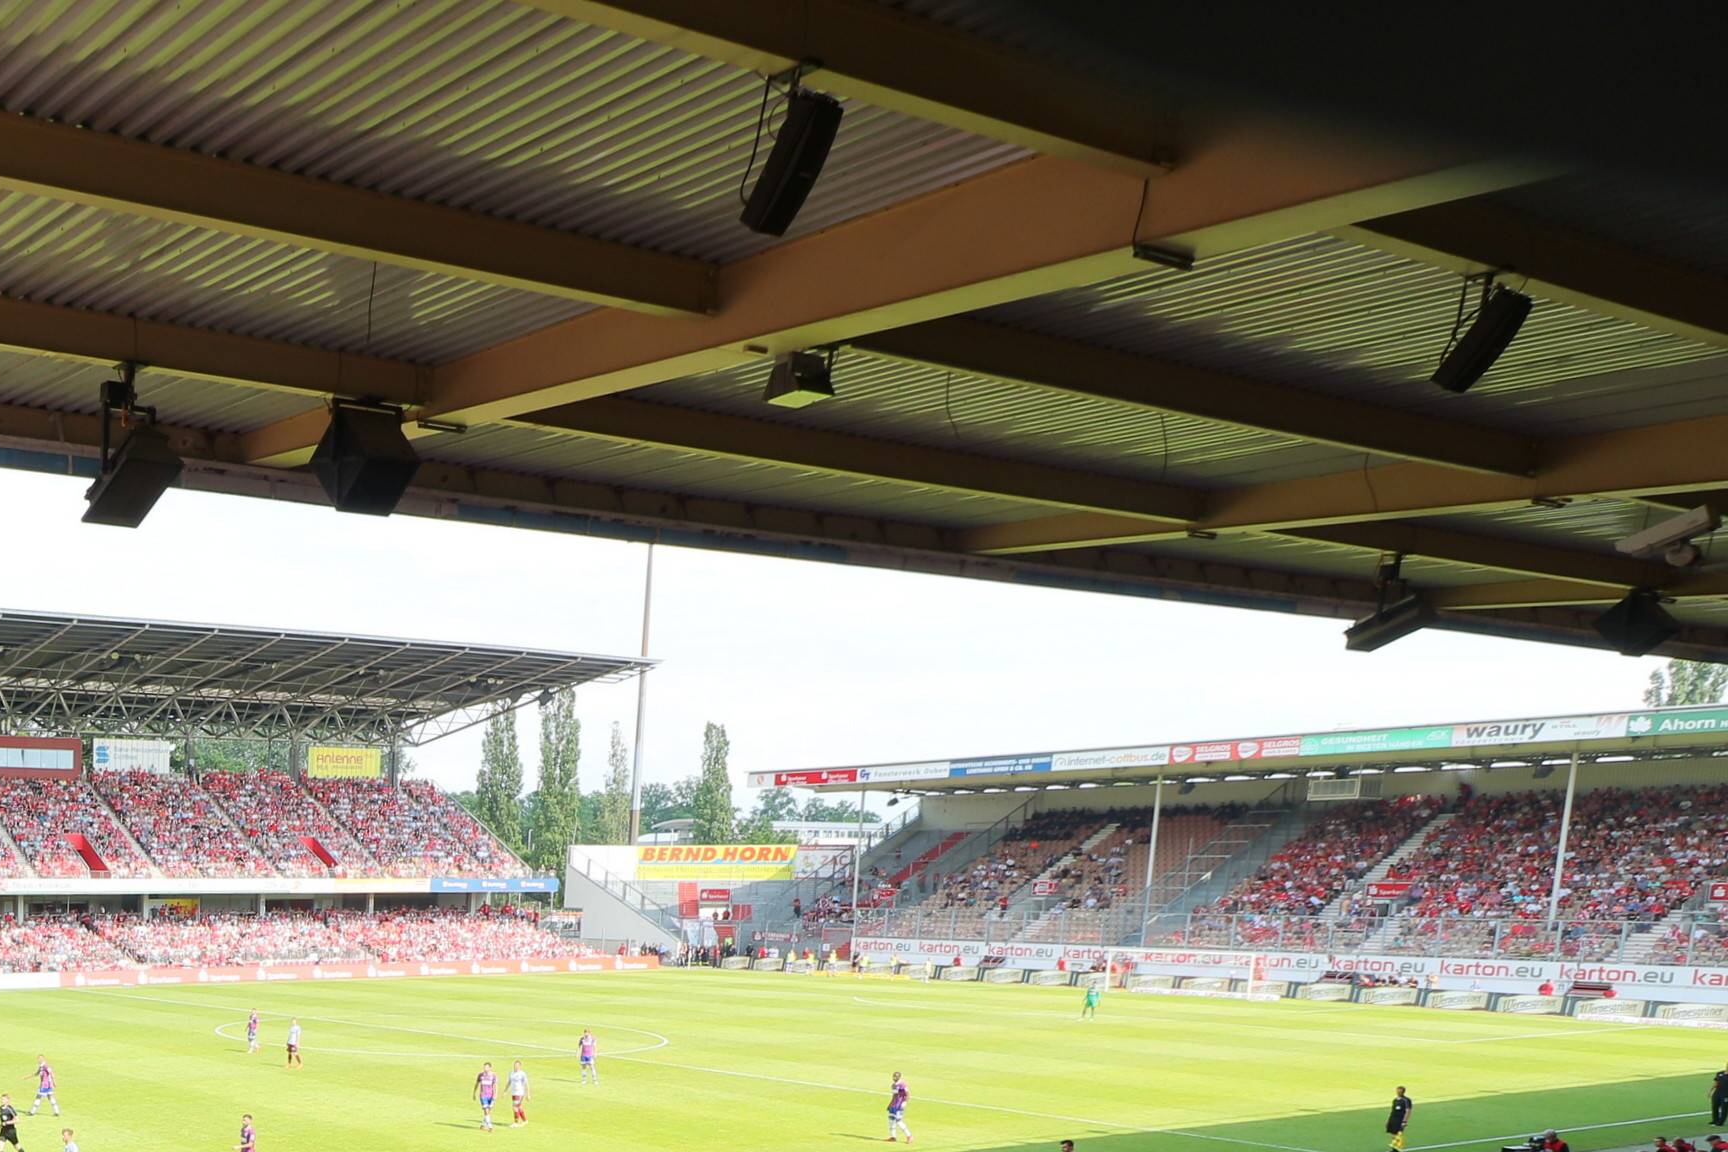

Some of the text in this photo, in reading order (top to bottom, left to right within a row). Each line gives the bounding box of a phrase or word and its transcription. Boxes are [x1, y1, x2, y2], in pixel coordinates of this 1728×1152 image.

[1466, 721, 1546, 739] waury
[1659, 717, 1718, 731] Ahorn
[1196, 739, 1300, 754] SELGROS SELGROS
[1321, 733, 1388, 746] GESUNDHEIT
[1067, 750, 1166, 768] internet-cottbus.de
[641, 846, 791, 862] BERND HORN
[855, 938, 912, 952] karton.eu
[918, 941, 980, 956] karton.eu
[987, 943, 1055, 959] karton.eu
[1331, 956, 1425, 975] karton.eu
[1439, 960, 1544, 979] karton.eu
[1559, 964, 1674, 984] karton.eu
